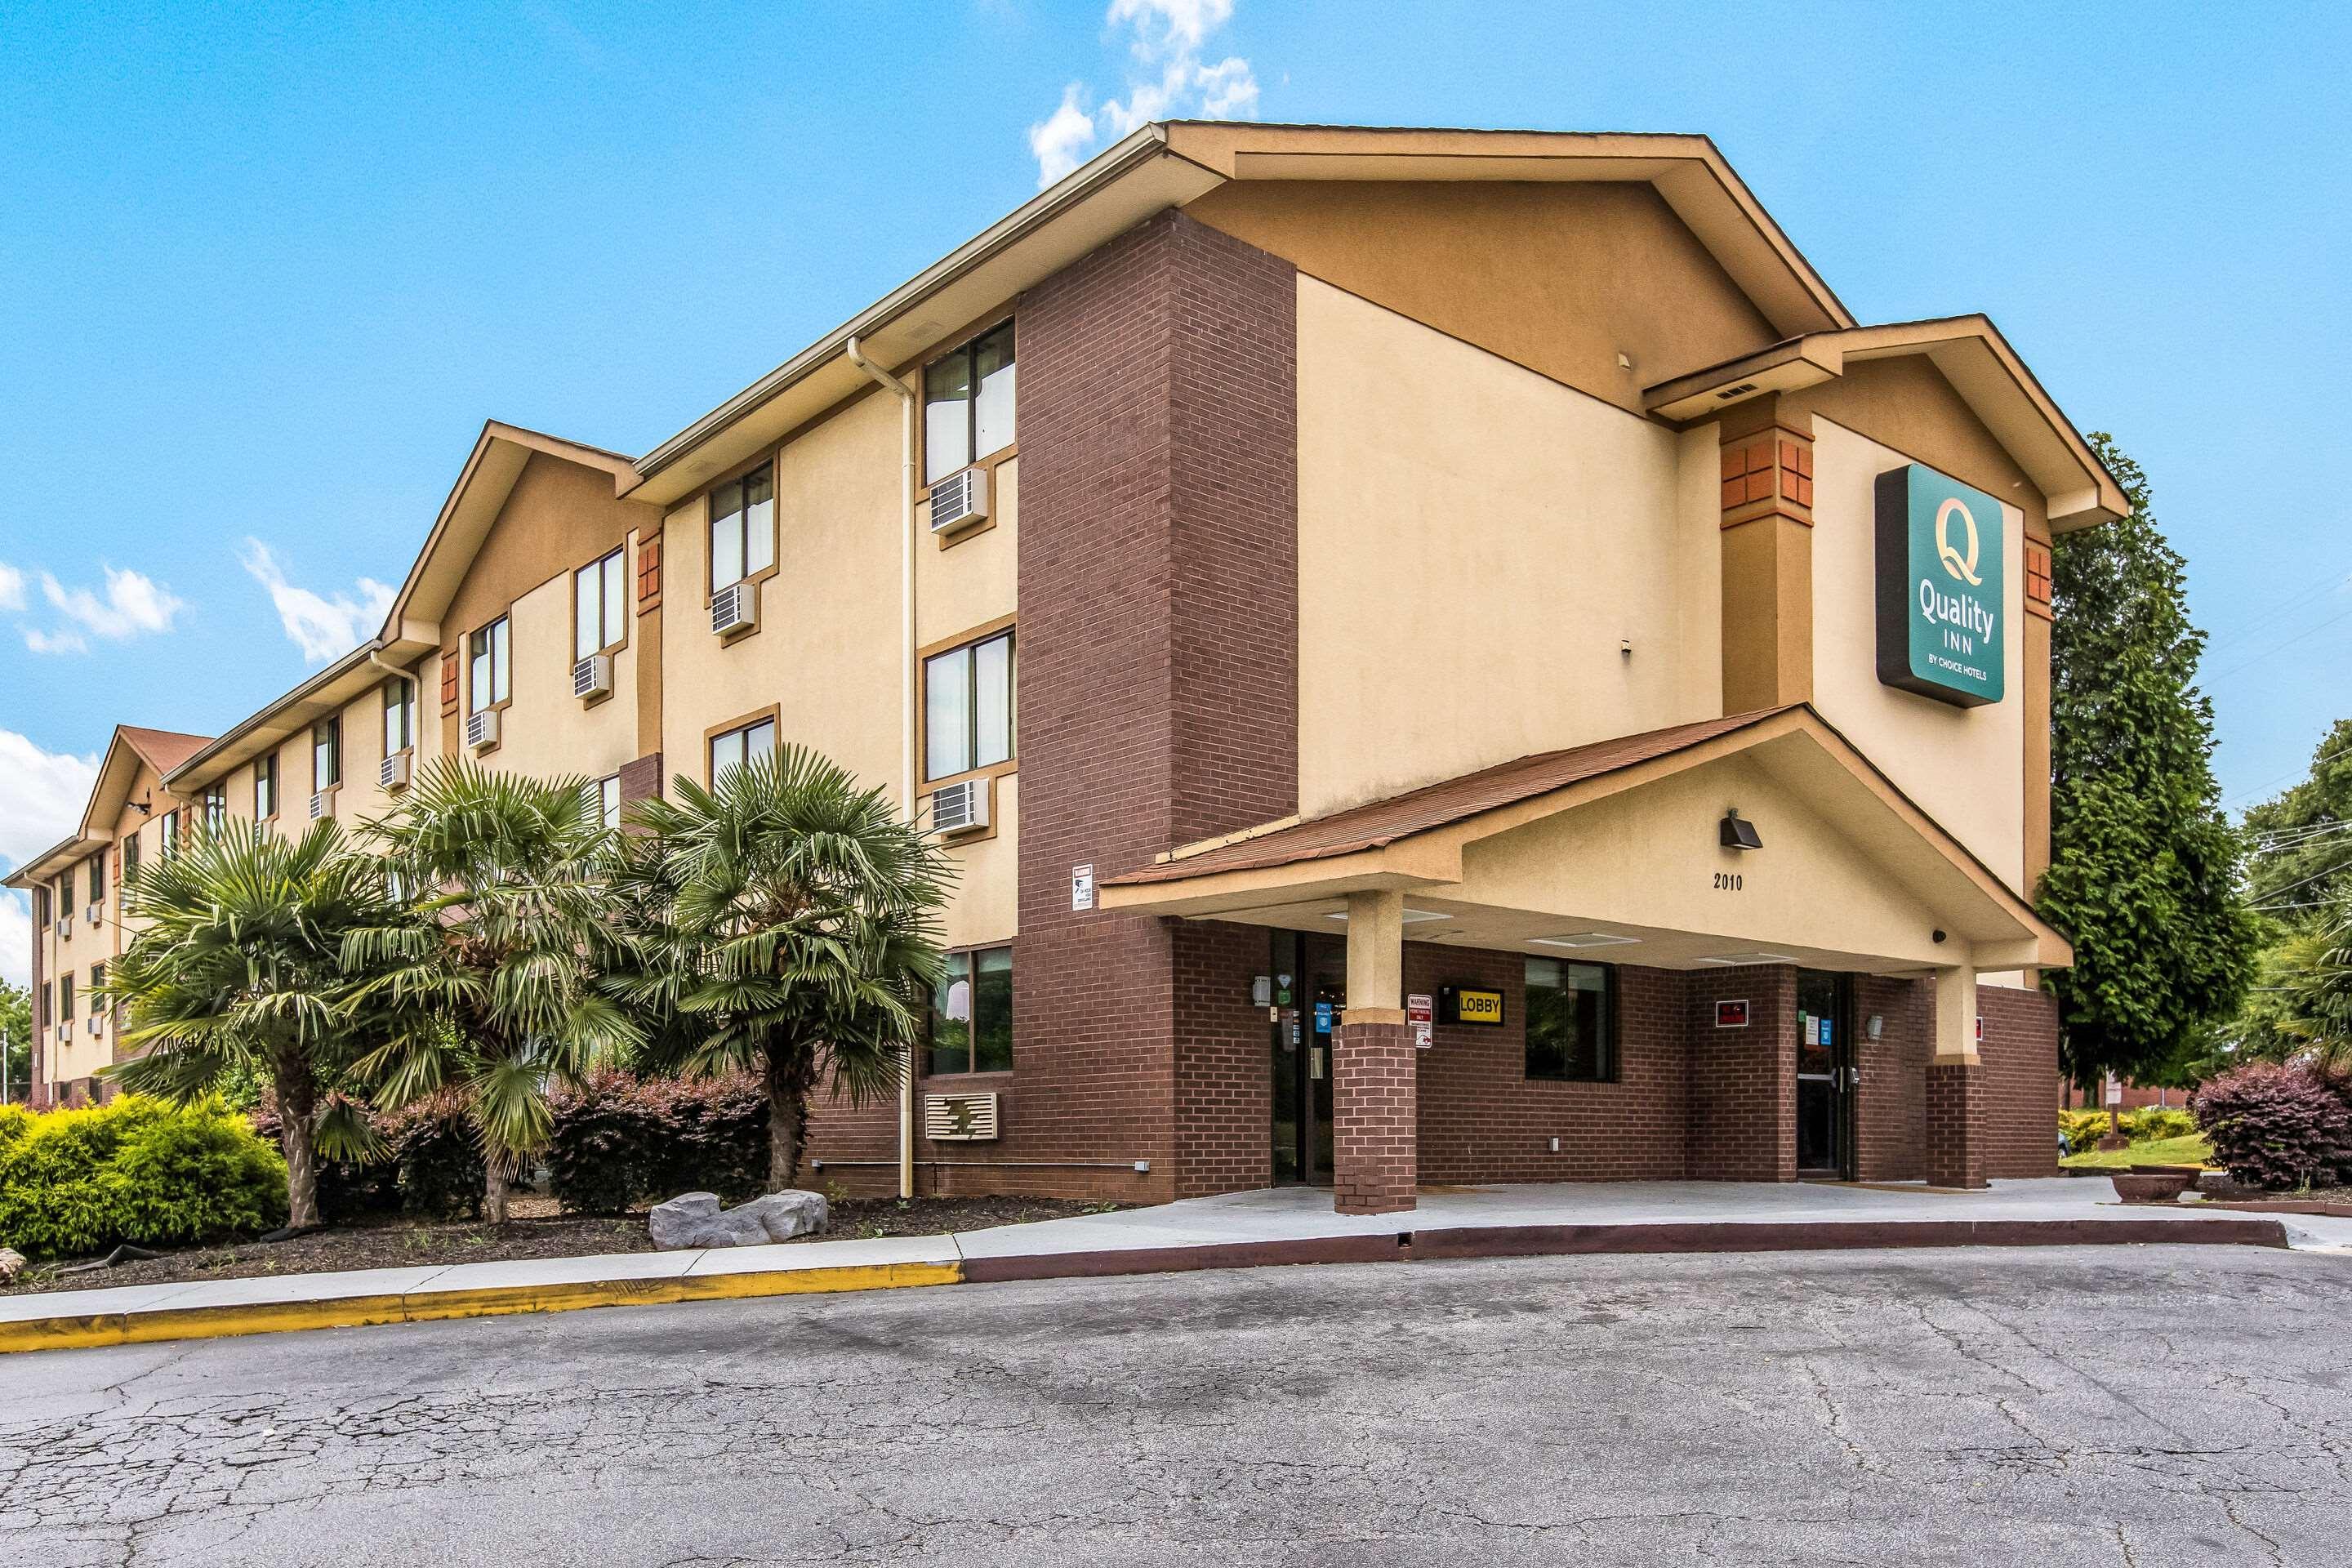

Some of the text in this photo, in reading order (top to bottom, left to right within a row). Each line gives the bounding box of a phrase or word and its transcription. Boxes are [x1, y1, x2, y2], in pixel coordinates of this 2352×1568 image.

[1936, 497, 1982, 586] Q
[1919, 578, 1993, 644] Quality
[1944, 628, 1972, 656] INN
[1928, 653, 1987, 681] BY CHOICE HOTELS
[1713, 872, 1743, 891] 2010
[1410, 998, 1430, 1007] WARNING
[1460, 997, 1499, 1013] LOBBY
